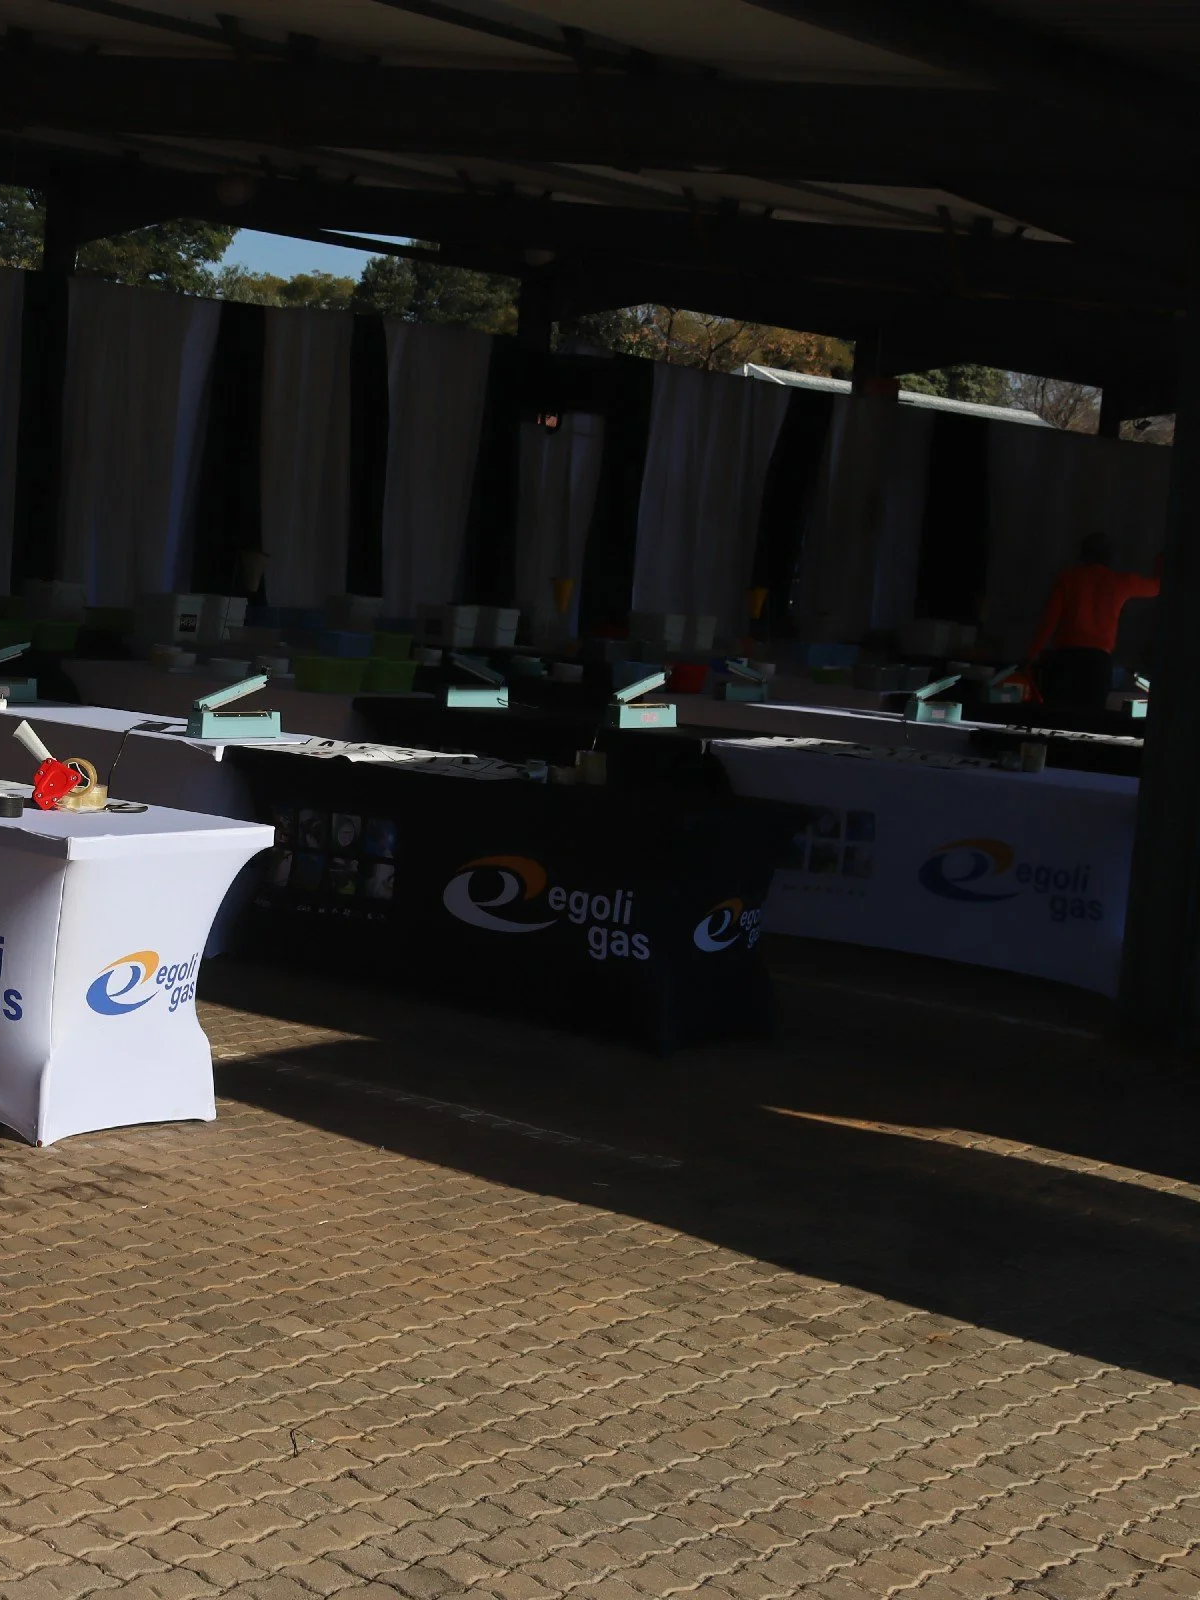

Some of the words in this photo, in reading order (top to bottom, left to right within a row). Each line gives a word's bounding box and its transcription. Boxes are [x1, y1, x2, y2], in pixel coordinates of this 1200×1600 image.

[1015, 863, 1092, 894] egoli
[549, 887, 633, 925] egoli
[1049, 893, 1103, 922] gas
[588, 926, 651, 961] gas
[156, 952, 198, 991] egoli
[169, 980, 195, 1012] gas
